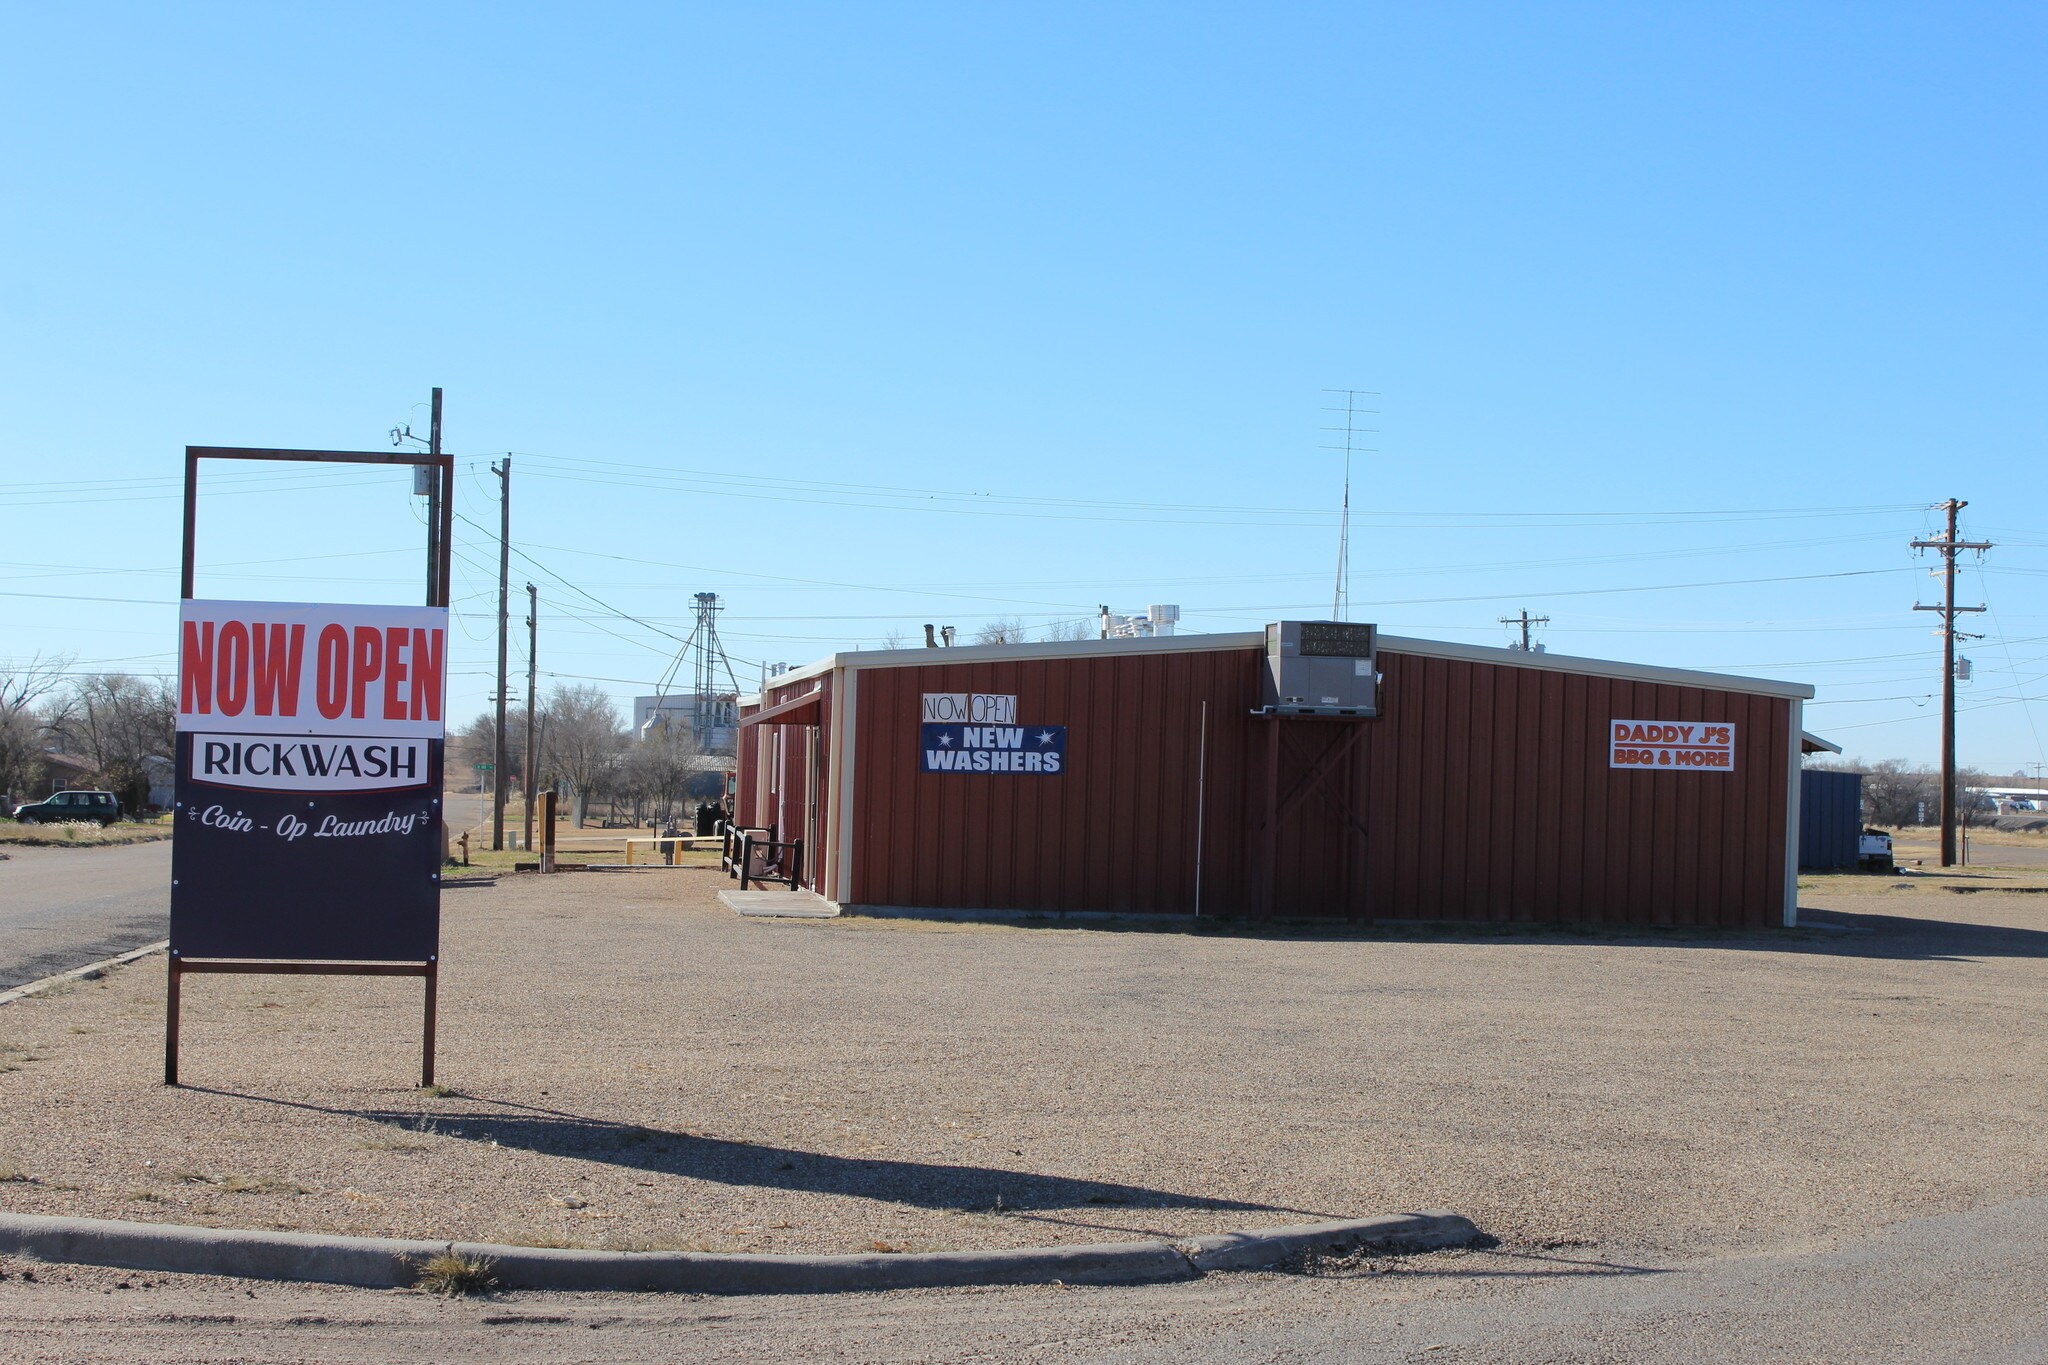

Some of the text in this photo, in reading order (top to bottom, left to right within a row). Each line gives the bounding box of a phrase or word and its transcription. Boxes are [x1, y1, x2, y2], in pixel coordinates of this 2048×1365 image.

[180, 620, 443, 721] NOW OPEN
[923, 694, 1016, 723] NOW OPEN
[963, 727, 1024, 748] NEW
[1614, 724, 1730, 744] DADDY J'S
[204, 742, 416, 778] RICKWASH
[926, 750, 1060, 772] WASHERS
[1614, 749, 1730, 767] BBQ & MORE
[201, 805, 253, 832] Coin
[276, 814, 307, 841] Op
[313, 811, 415, 837] Laundry
